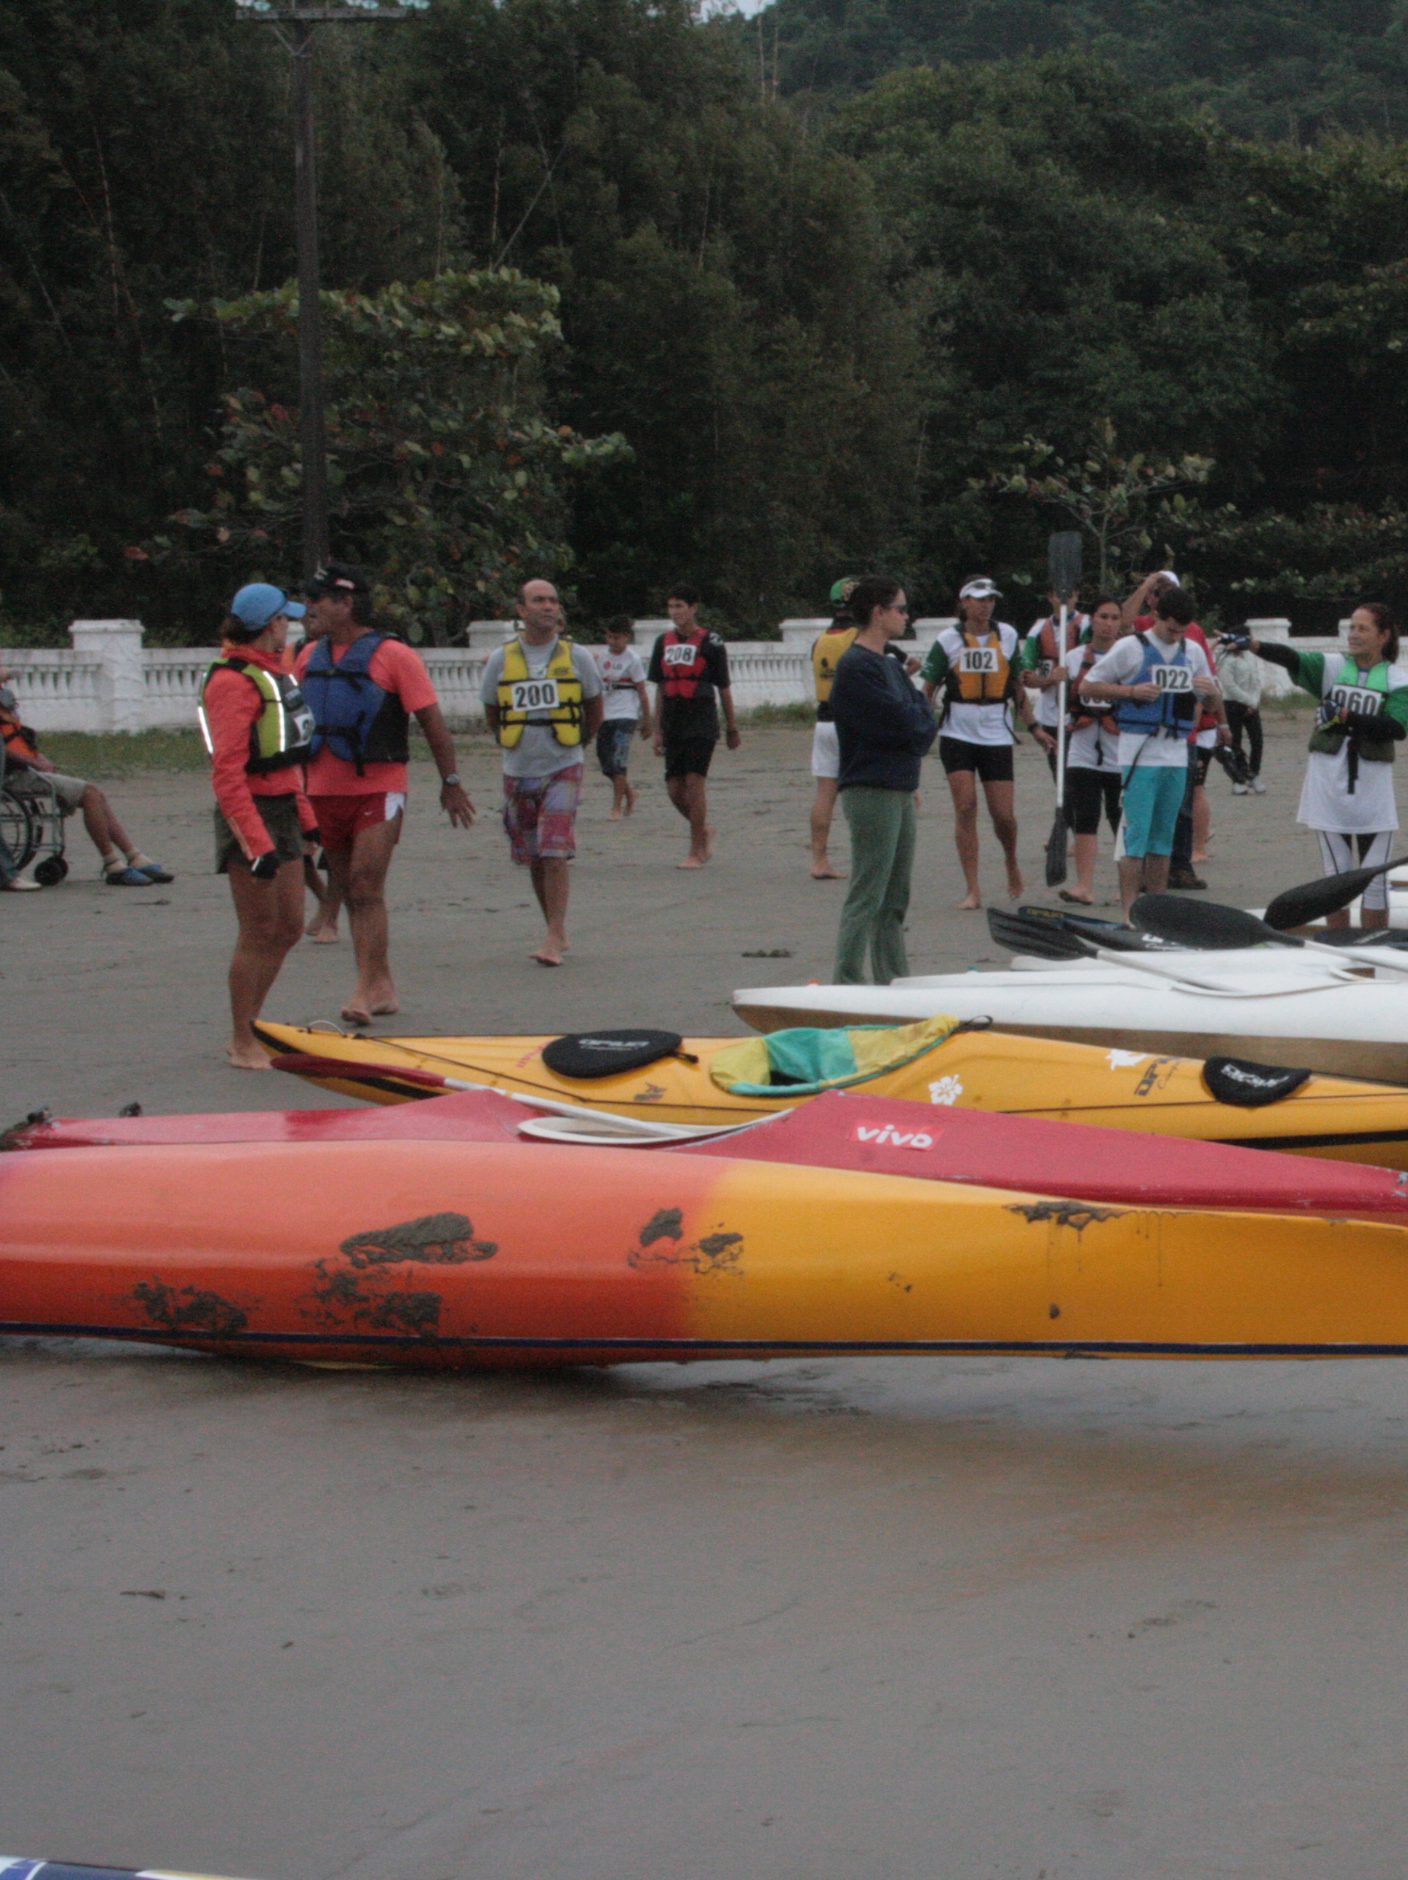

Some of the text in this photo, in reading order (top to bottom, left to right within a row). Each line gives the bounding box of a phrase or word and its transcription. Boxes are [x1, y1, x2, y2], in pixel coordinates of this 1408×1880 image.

[667, 647, 691, 662] 208
[964, 651, 993, 669] 102
[1155, 668, 1191, 690] 022
[515, 684, 555, 708] 200
[857, 1124, 933, 1148] vivo
